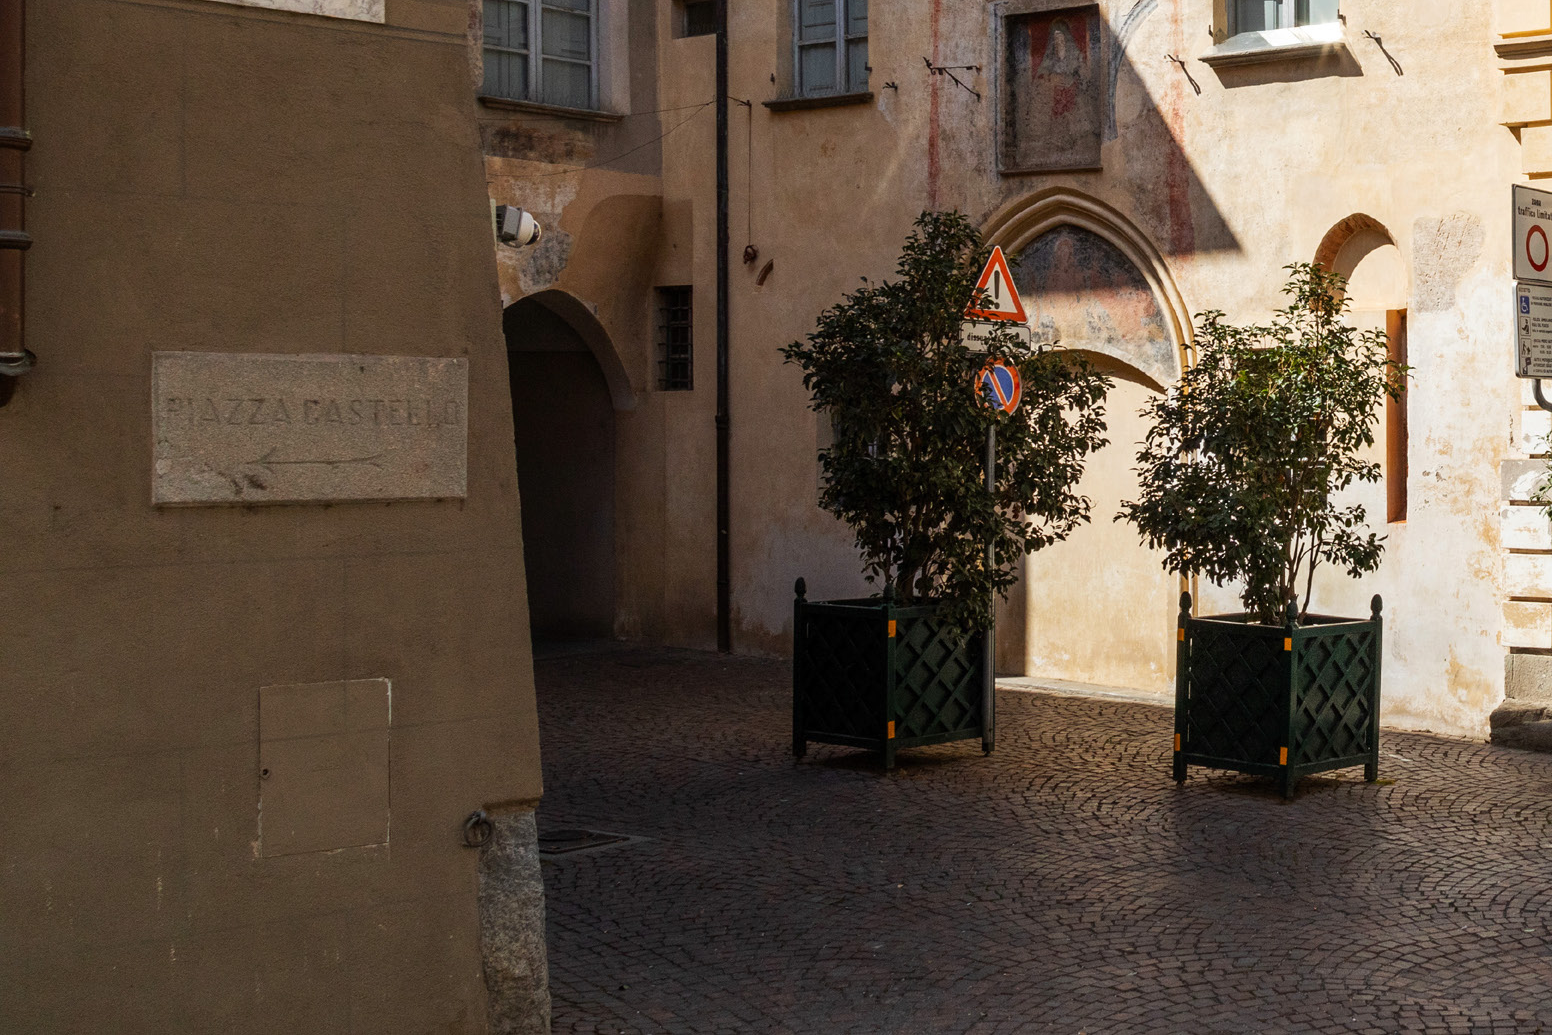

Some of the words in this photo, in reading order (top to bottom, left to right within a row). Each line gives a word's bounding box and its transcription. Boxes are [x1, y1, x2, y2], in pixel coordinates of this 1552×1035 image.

[1517, 206, 1536, 218] traffico
[167, 397, 291, 425] PIAZZA
[303, 398, 460, 427] CASTELLO
